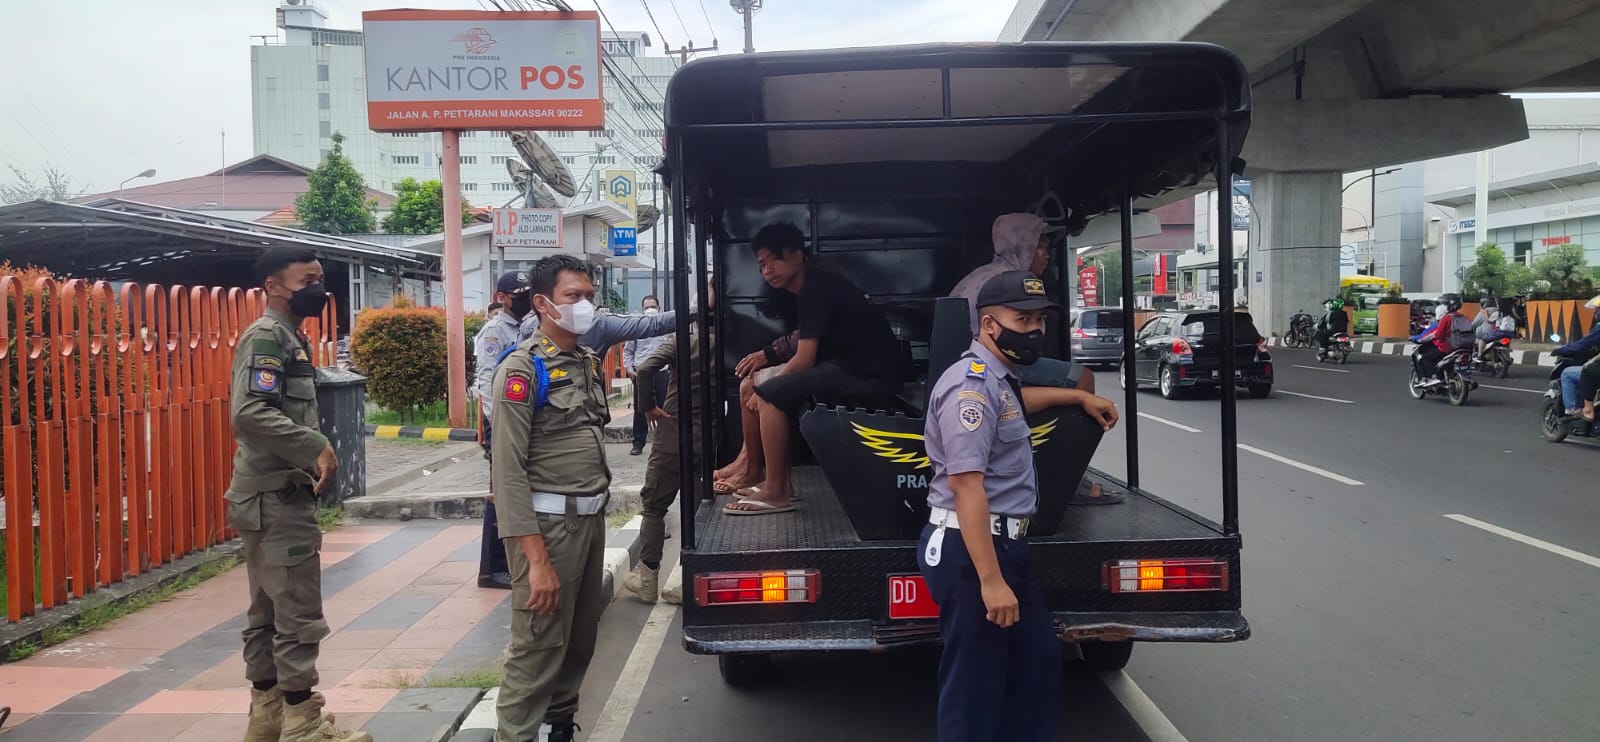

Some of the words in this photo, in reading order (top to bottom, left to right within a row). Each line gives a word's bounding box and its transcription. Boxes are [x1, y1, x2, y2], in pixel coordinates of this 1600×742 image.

[386, 66, 509, 92] KANTOR
[519, 65, 586, 91] POS
[386, 110, 420, 120] JALAN
[444, 109, 498, 119] PETTARANI
[500, 109, 555, 118] MAKASSAR
[556, 108, 584, 118] 90222
[521, 214, 538, 223] PHOTO
[539, 214, 553, 223] COPY
[896, 474, 930, 489] PRA
[892, 579, 917, 604] DD
